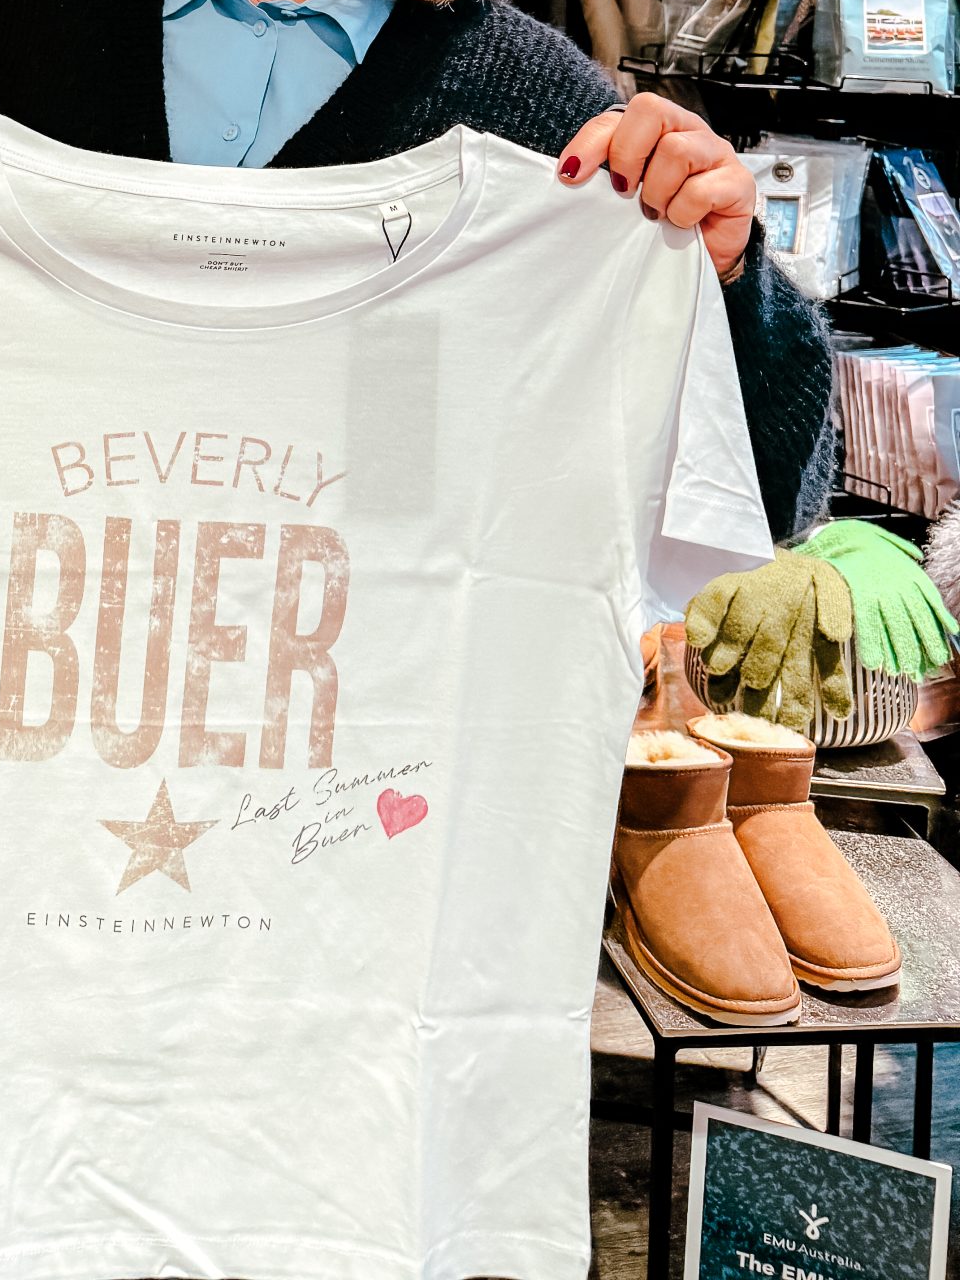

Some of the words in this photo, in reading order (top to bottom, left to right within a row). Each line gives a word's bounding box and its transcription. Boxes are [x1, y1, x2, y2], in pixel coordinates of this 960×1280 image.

[389, 204, 398, 212] M
[172, 233, 286, 248] EINSTEINNEWTON
[51, 431, 345, 507] BEVERLY
[231, 787, 301, 830] Last
[313, 760, 433, 806] Summer
[324, 805, 355, 824] in
[291, 822, 372, 865] Buer
[26, 912, 272, 933] EINSTEINNEWTON
[763, 1232, 797, 1252] EMU
[736, 1250, 776, 1276] The
